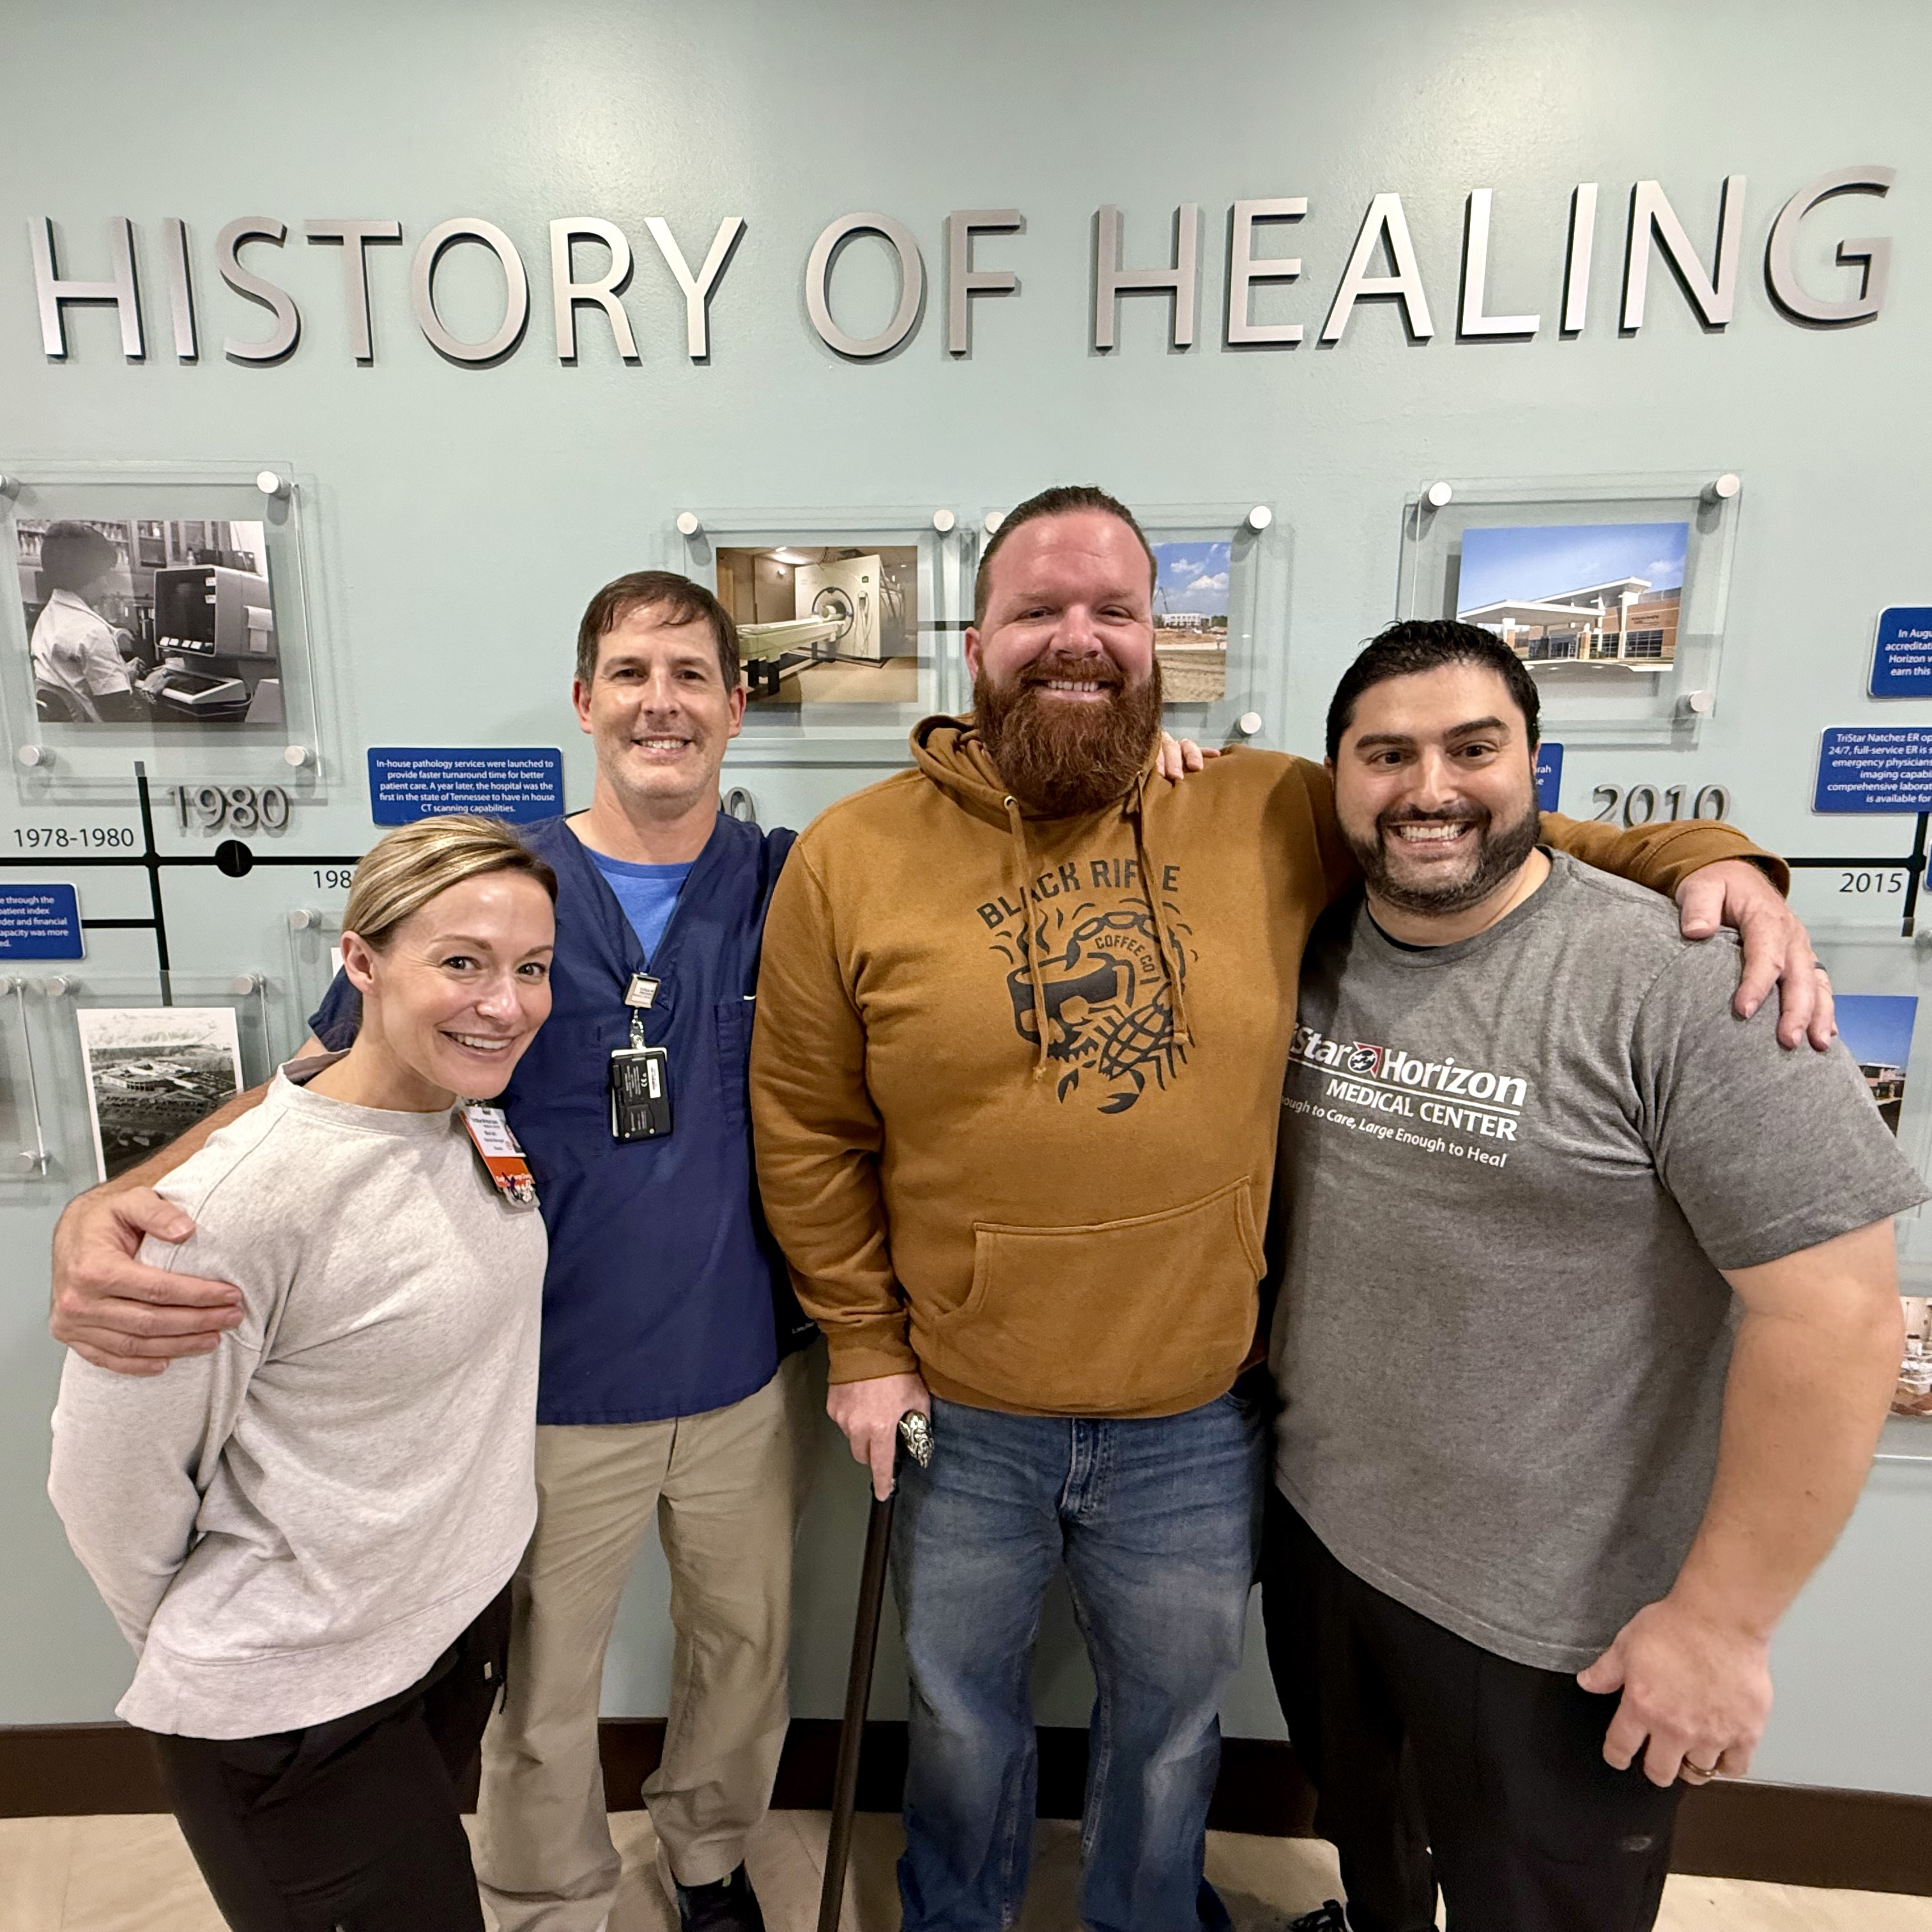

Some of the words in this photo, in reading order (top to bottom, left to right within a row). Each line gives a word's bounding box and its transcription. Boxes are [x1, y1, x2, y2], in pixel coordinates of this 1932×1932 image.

[28, 216, 747, 365] HISTORY
[804, 210, 1026, 360] OF
[1094, 165, 1897, 355] HEALING
[1898, 629, 1908, 638] In
[1889, 654, 1926, 663] Horizon
[1913, 666, 1931, 676] this
[1837, 733, 1866, 743] TriStar
[1867, 733, 1905, 742] Natchez
[1906, 733, 1919, 742] ER
[1828, 746, 1852, 755] 24/7,
[1853, 745, 1904, 755] full-service
[1906, 746, 1918, 755] ER
[1919, 746, 1927, 755] is
[376, 759, 411, 768] In-house
[413, 759, 452, 769] pathology
[454, 760, 486, 768] services
[507, 759, 543, 768] launched
[1832, 760, 1884, 769] emergency
[387, 770, 418, 780] provide
[418, 770, 441, 779] faster
[442, 770, 487, 779] turnaround
[488, 770, 506, 779] time
[507, 770, 519, 779] for
[520, 770, 544, 779] better
[1860, 770, 1899, 780] imaging
[380, 782, 408, 791] patient
[437, 784, 454, 792] year
[456, 782, 475, 792] later,
[491, 782, 522, 792] hospital
[1827, 782, 1897, 792] comprehensive
[379, 793, 395, 801] first
[441, 793, 449, 801] of
[450, 793, 491, 801] Tennessee
[502, 793, 521, 801] have
[531, 793, 555, 801] house
[1866, 794, 1873, 802] is
[1875, 793, 1916, 803] available
[1918, 793, 1931, 803] for
[167, 785, 290, 830] 1980
[421, 804, 432, 812] CT
[433, 804, 469, 813] scanning
[470, 804, 516, 814] capabilities.
[1593, 783, 1731, 828] 2010
[14, 828, 134, 848] 1978-1980
[313, 870, 356, 889] 198
[1090, 858, 1181, 892] RIFE
[1839, 872, 1903, 893] 2015
[6, 896, 39, 905] through
[40, 896, 54, 904] the
[17, 917, 32, 926] and
[33, 917, 67, 926] financial
[1094, 934, 1146, 956] COFFEE
[1380, 1049, 1528, 1107] Horizon
[1326, 1078, 1414, 1117] MEDICAL
[1420, 1101, 1517, 1142] CENTER
[1312, 1105, 1325, 1118] to
[1326, 1108, 1357, 1130] Care,
[1359, 1118, 1394, 1139] Large
[1395, 1131, 1446, 1153] Enough
[1448, 1142, 1464, 1157] to
[1467, 1146, 1507, 1168] Heal
